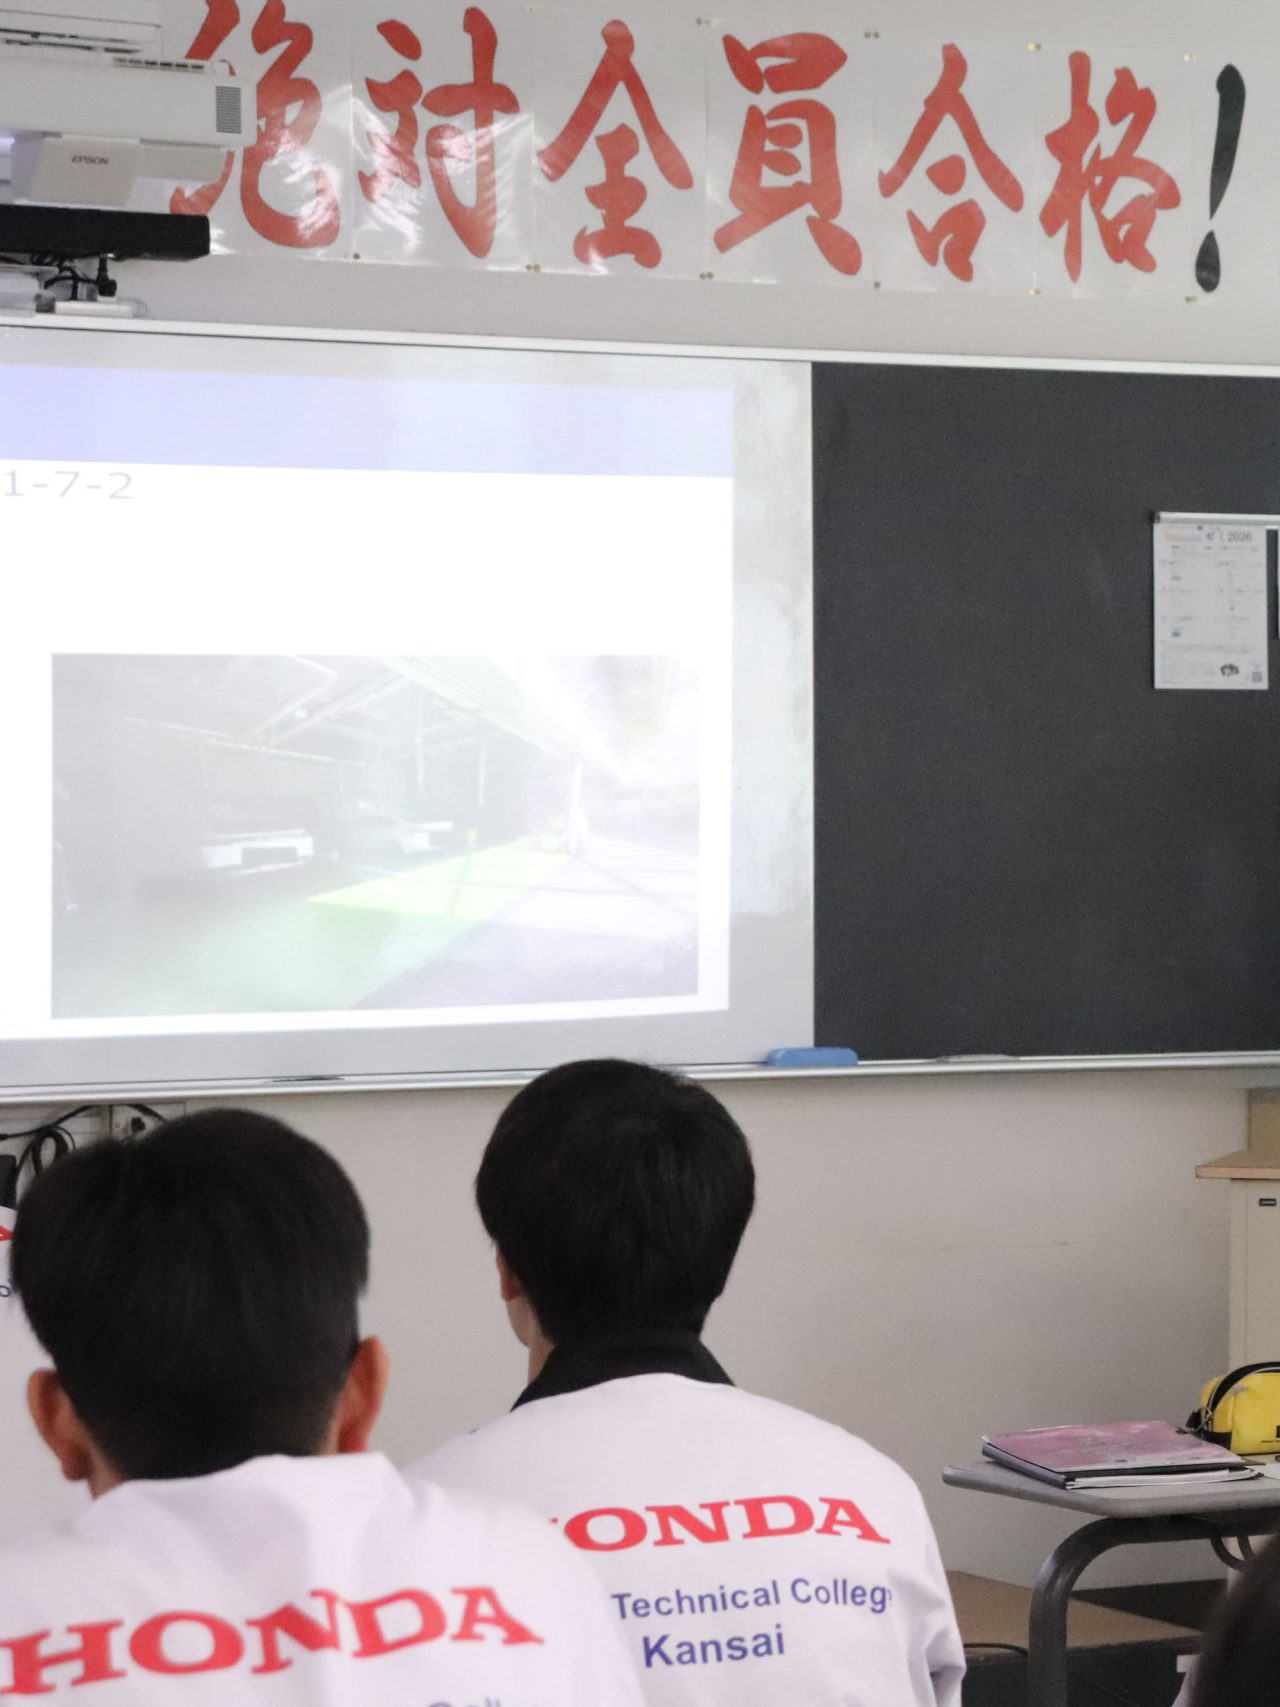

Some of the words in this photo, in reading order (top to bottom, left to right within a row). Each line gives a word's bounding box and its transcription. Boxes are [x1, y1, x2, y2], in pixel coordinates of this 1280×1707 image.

[71, 154, 109, 165] EPSON
[3, 469, 134, 500] 1-7-2
[550, 1495, 892, 1552] ONDA
[611, 1579, 781, 1620] Technical
[790, 1577, 893, 1614] Colleg
[0, 1586, 545, 1695] HONDA
[642, 1624, 785, 1668] Kansai
